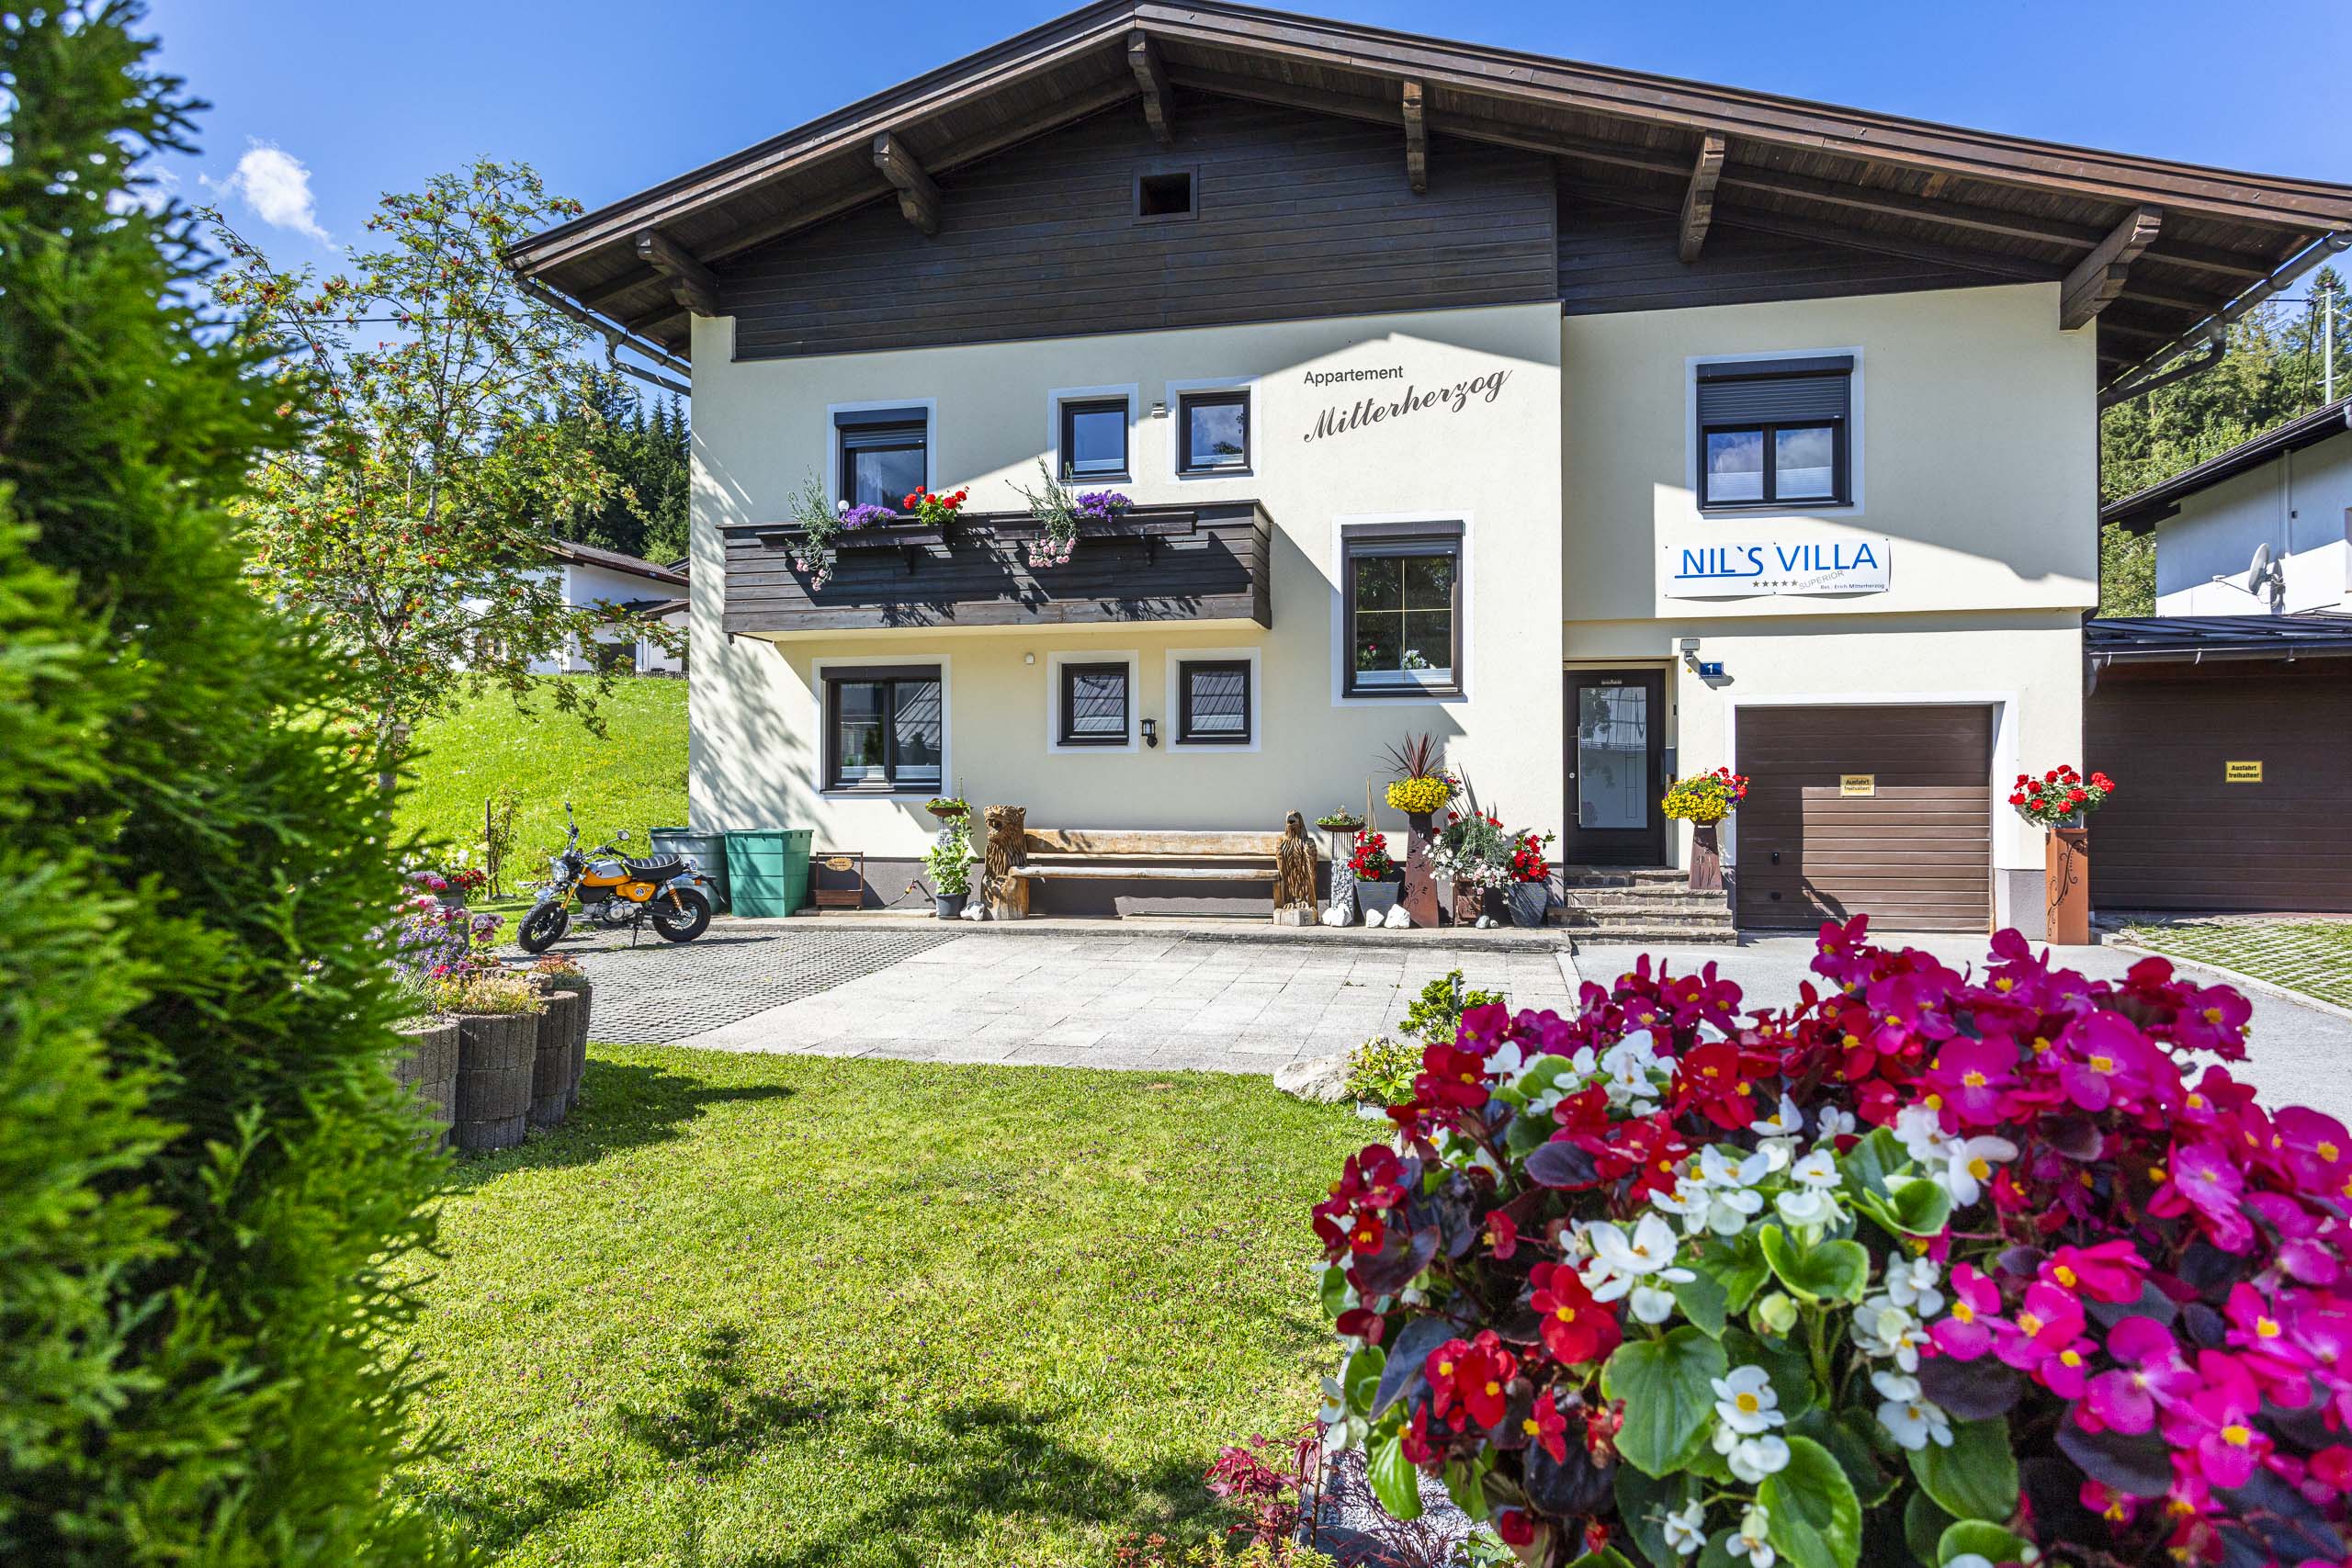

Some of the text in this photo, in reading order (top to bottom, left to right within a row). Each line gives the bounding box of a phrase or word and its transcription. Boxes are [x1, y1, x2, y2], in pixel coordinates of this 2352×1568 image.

[1304, 366, 1404, 387] Appartement
[1303, 368, 1513, 443] Mitterherzog
[1776, 543, 1879, 571] VILLA
[1799, 570, 1845, 590] SUPERIOR
[1707, 664, 1713, 673] 1
